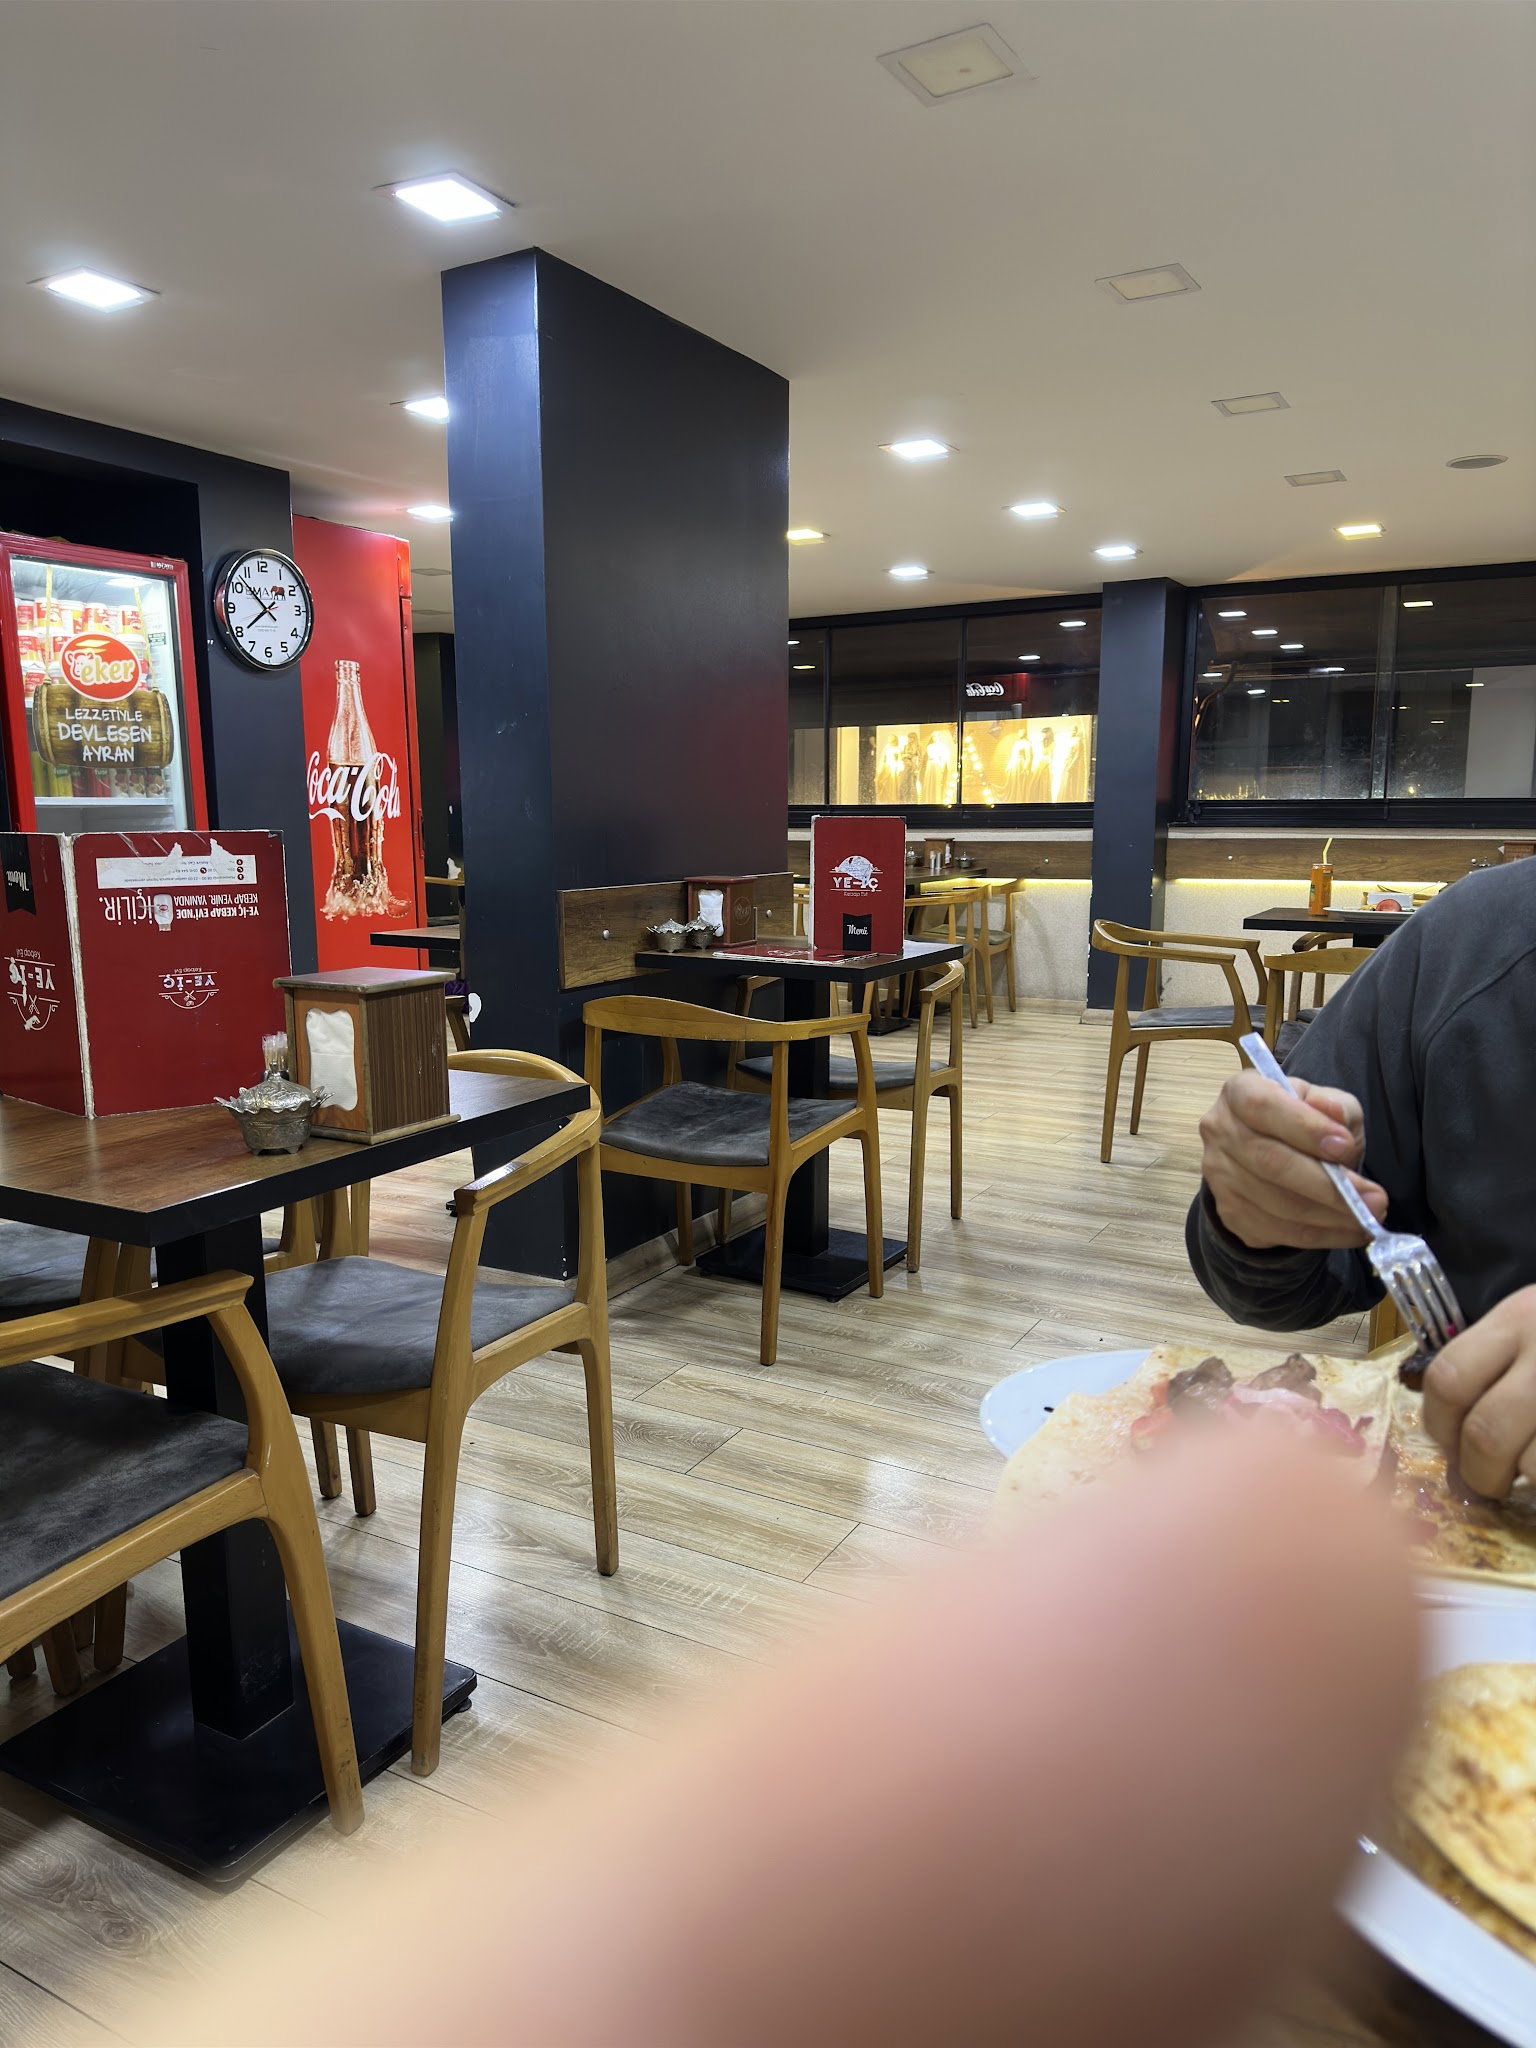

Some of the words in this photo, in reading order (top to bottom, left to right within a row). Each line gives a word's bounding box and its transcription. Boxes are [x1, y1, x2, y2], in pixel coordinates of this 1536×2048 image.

[244, 566, 251, 579] 11
[257, 561, 268, 573] 12
[231, 581, 244, 594] 10
[288, 585, 296, 597] 2
[228, 602, 236, 614] 9
[294, 605, 302, 616] 3
[235, 626, 244, 638] 8
[290, 627, 299, 639] 4
[248, 641, 256, 653] 7
[264, 647, 273, 658] 6
[280, 641, 289, 653] 5
[65, 707, 143, 722] LEZZETİYLE
[57, 721, 152, 744] DEVLEŞEN
[82, 745, 135, 762] AYRAN
[173, 895, 207, 907] YANINDA
[233, 893, 259, 905] KEBAP
[176, 908, 209, 921] EVİ'NDE
[210, 906, 237, 918] KEBAP
[237, 904, 259, 919] YE-İÇ
